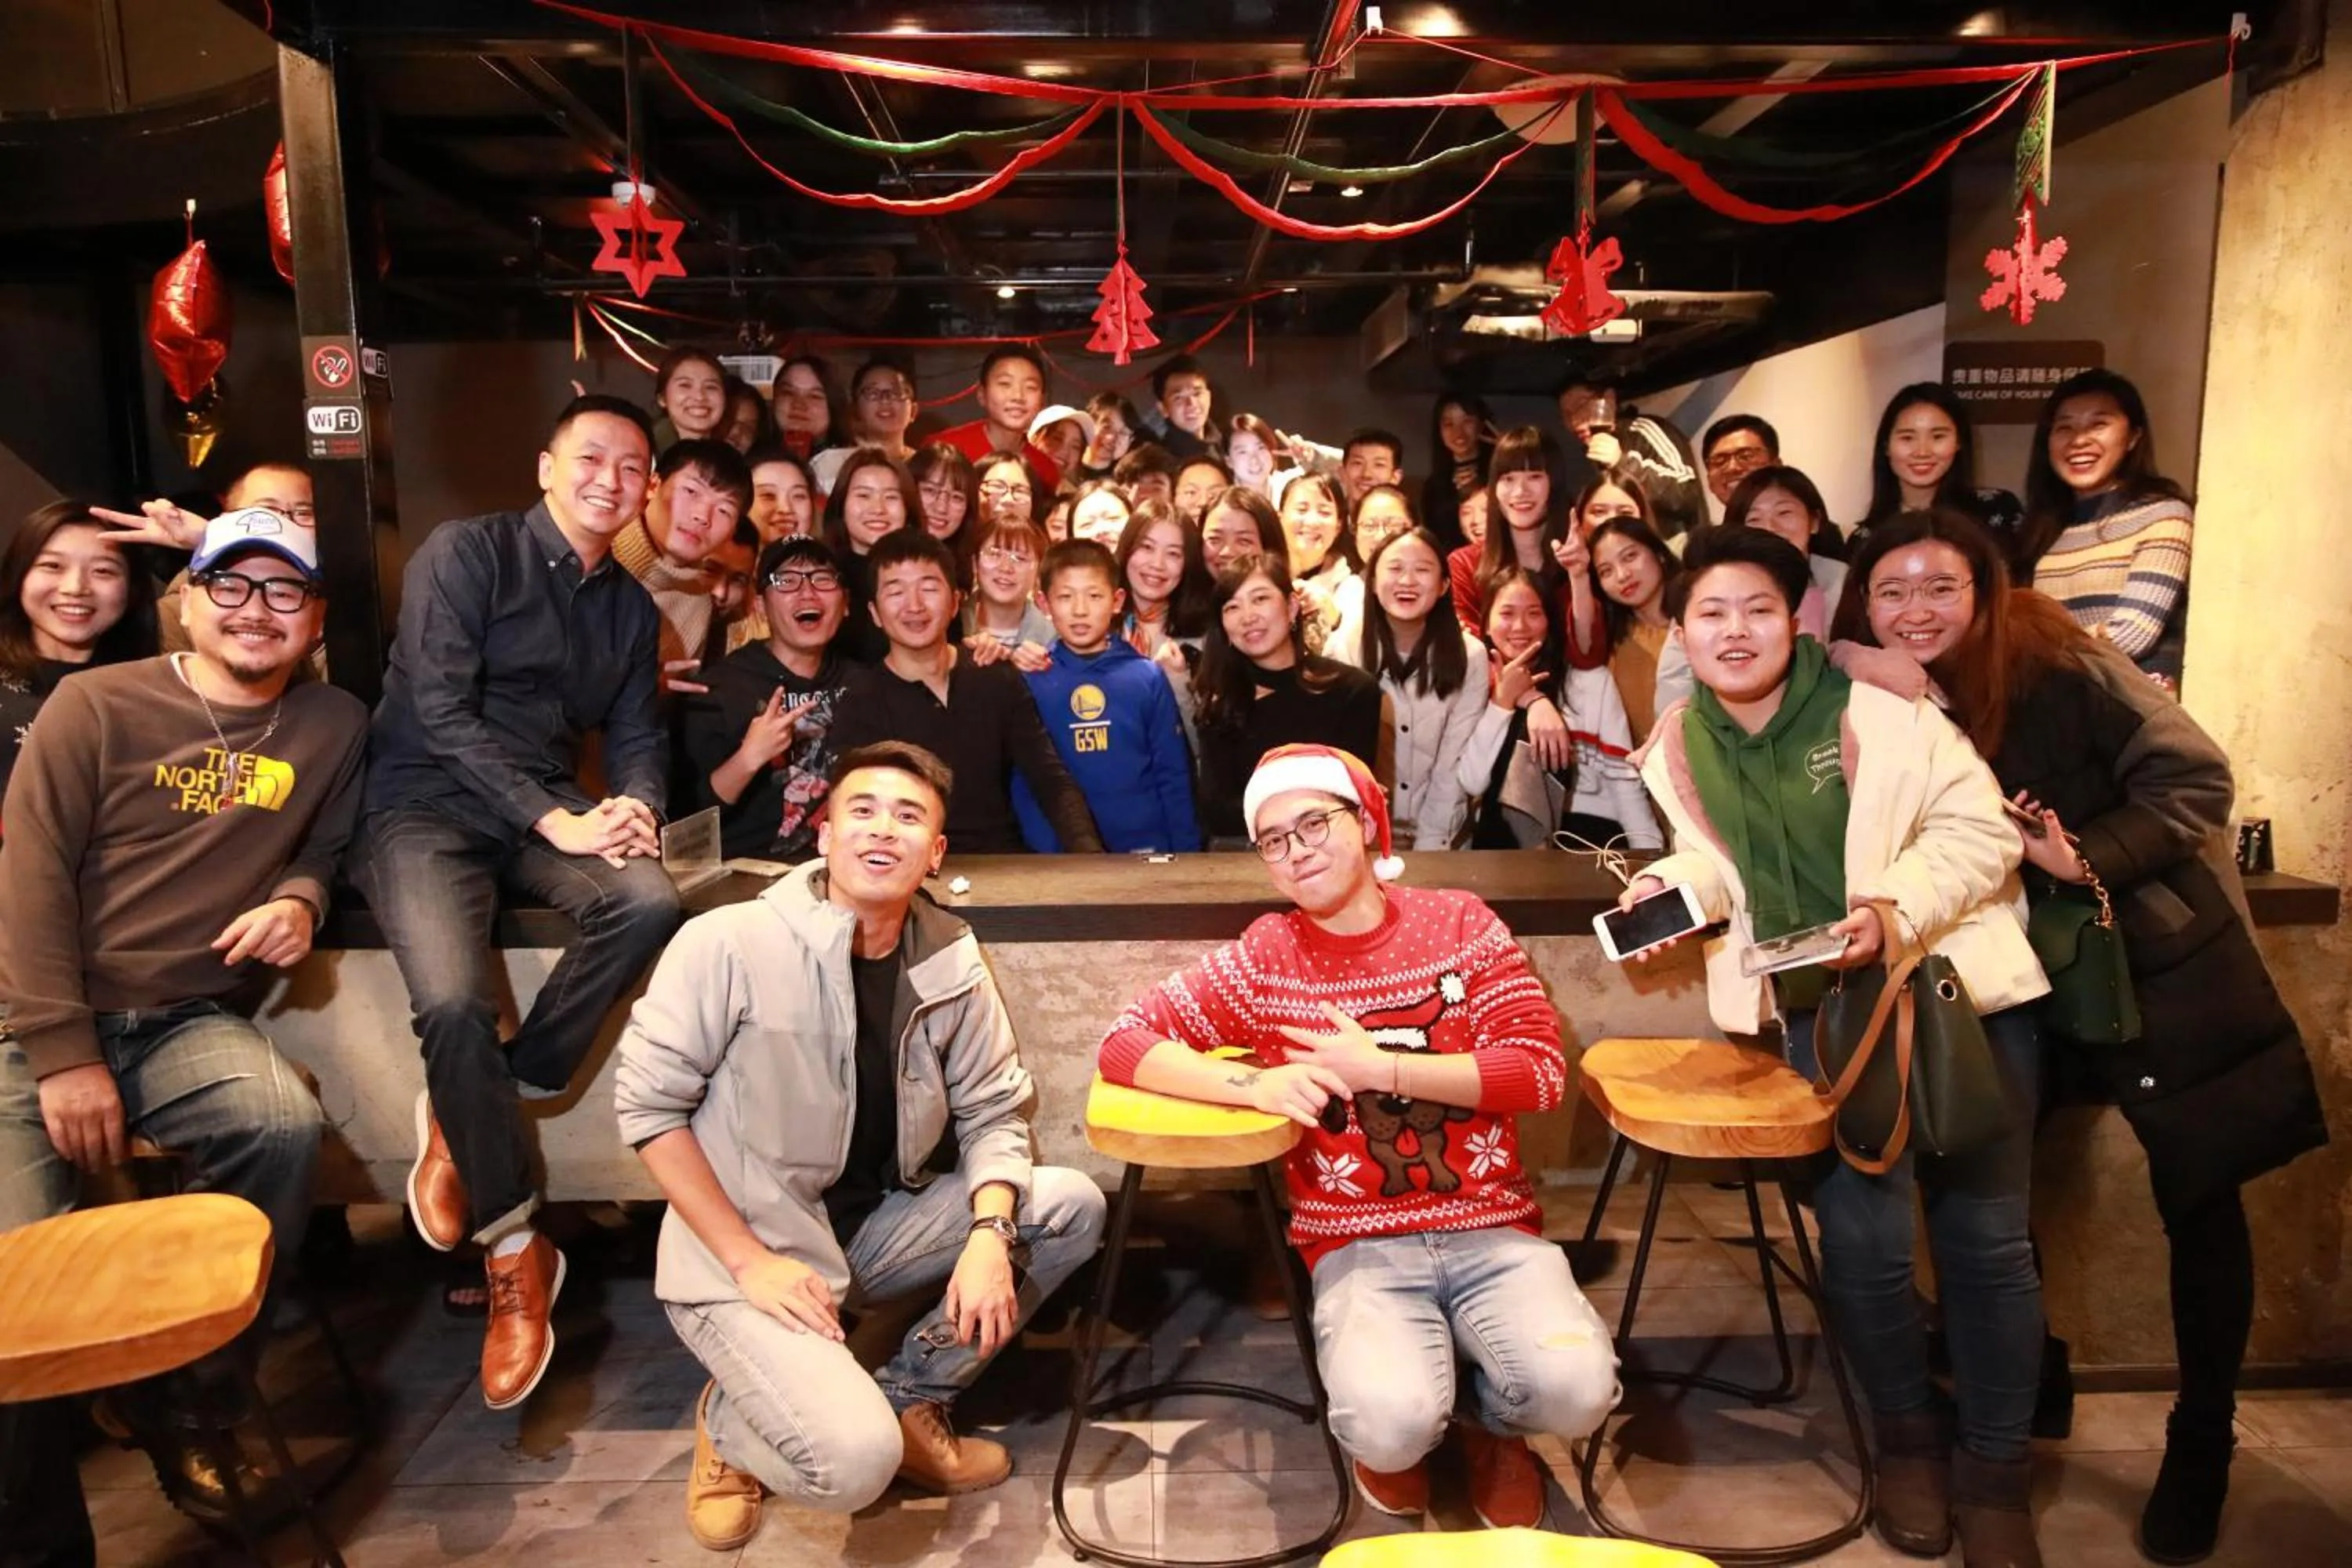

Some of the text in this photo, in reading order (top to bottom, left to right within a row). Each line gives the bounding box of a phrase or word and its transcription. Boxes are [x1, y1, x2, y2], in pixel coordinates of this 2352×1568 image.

[1952, 367, 2092, 384] 贵重物品请随身保
[1975, 390, 1998, 400] CARE
[1999, 390, 2013, 400] OF
[2015, 390, 2040, 400] YOUR
[1075, 727, 1108, 753] GSW
